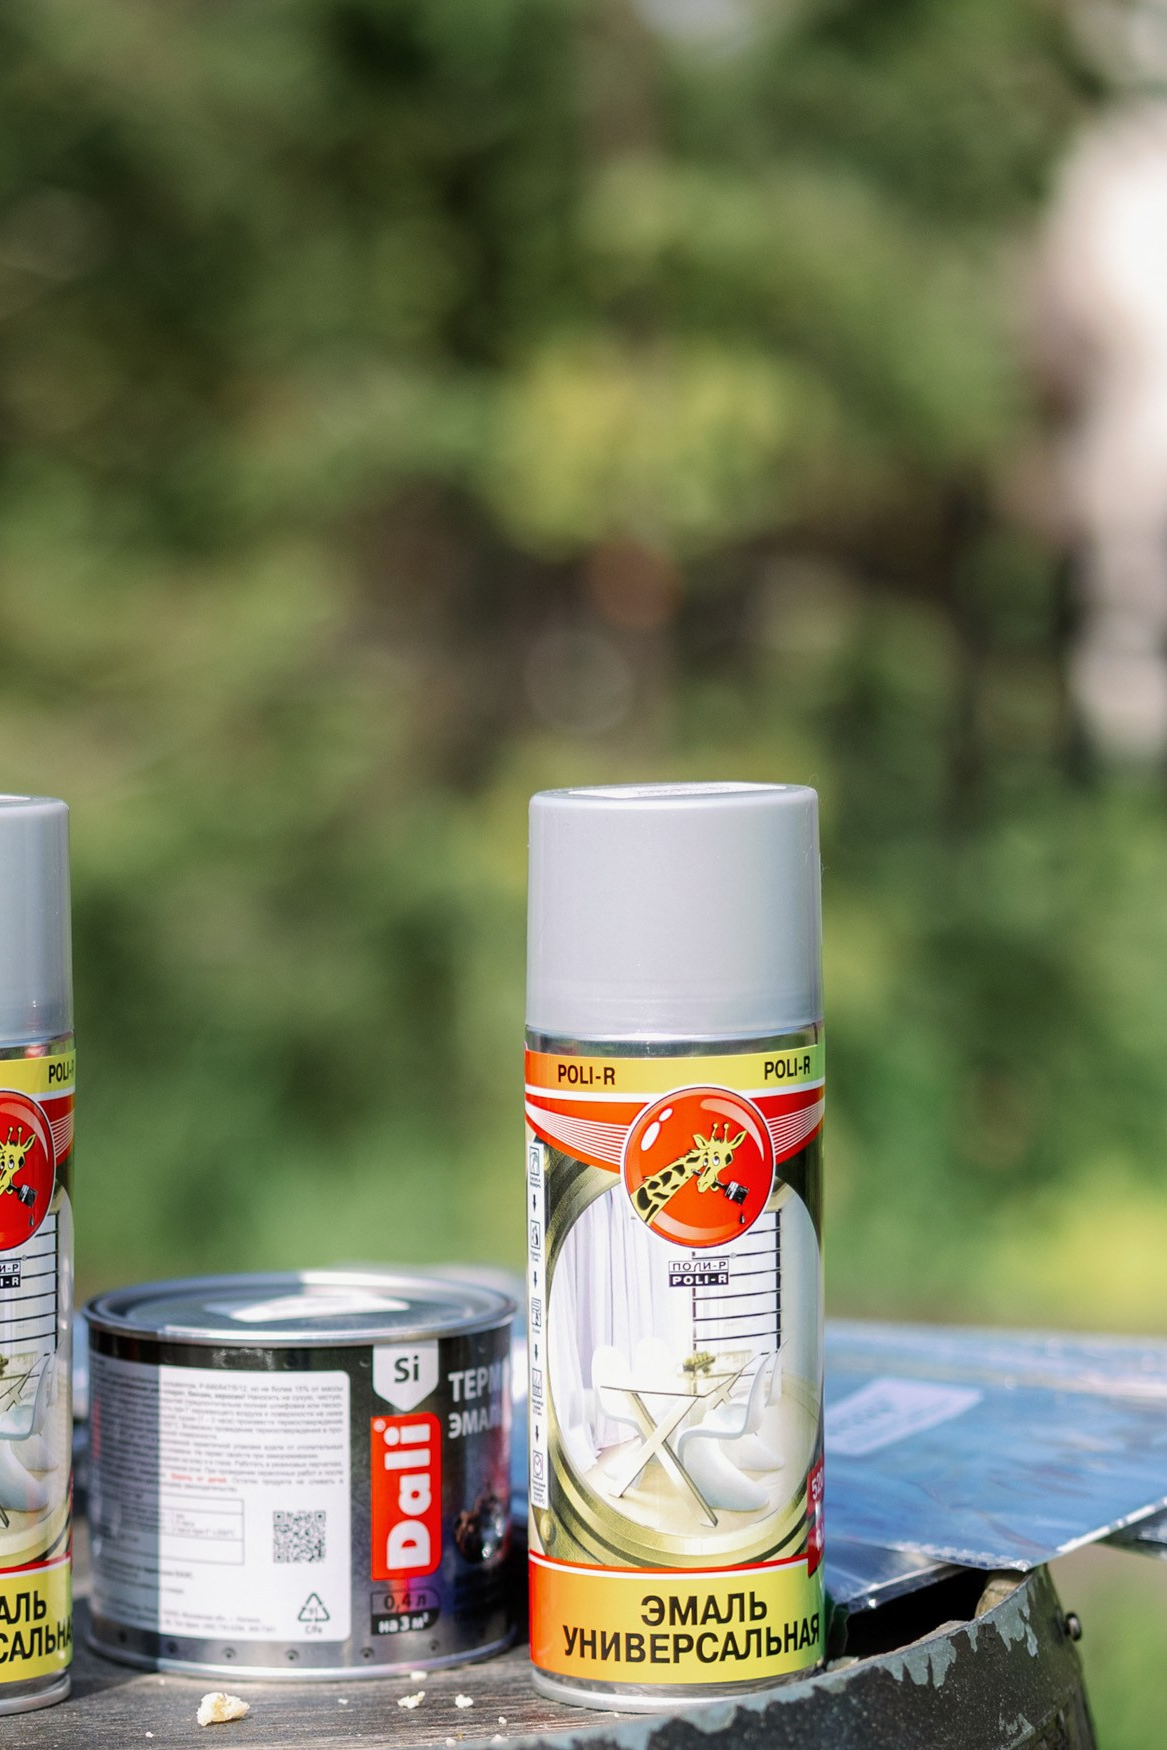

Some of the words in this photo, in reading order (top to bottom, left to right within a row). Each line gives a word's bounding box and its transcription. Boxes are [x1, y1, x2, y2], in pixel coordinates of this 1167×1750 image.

[557, 1063, 615, 1085] POLI-R
[764, 1055, 811, 1080] POLI-R
[672, 1261, 726, 1272] ПОЛИ-Р
[672, 1273, 727, 1285] POLI-R
[393, 1354, 420, 1383] Si
[384, 1422, 432, 1571] Dali
[641, 1591, 768, 1627] ЭМАЛЬ
[378, 1619, 399, 1634] на
[400, 1615, 410, 1632] 3
[563, 1612, 820, 1663] УНИВЕРСАЛЬНАЯ
